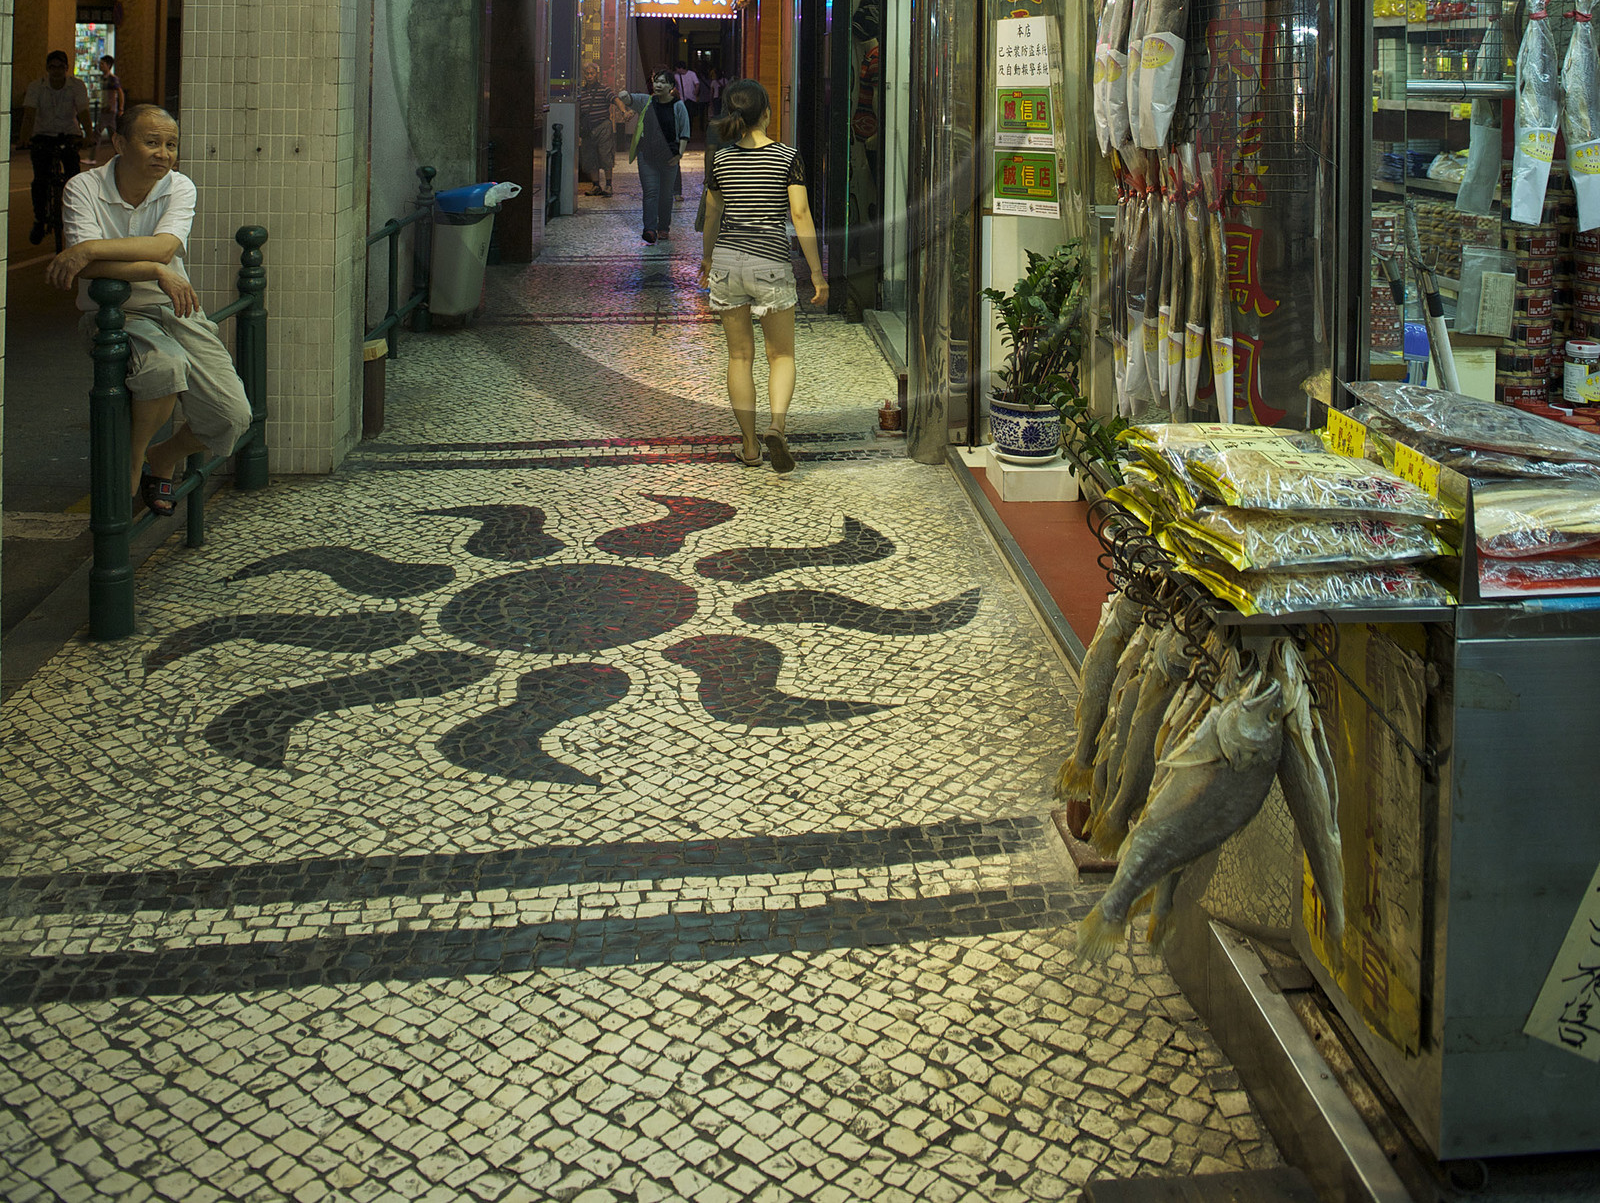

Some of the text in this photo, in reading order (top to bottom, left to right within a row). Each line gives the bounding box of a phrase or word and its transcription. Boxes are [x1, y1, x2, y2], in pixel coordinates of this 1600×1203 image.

[1017, 24, 1032, 38] 本店
[1004, 99, 1047, 121] 誠信店
[1003, 164, 1052, 187] 誠信店
